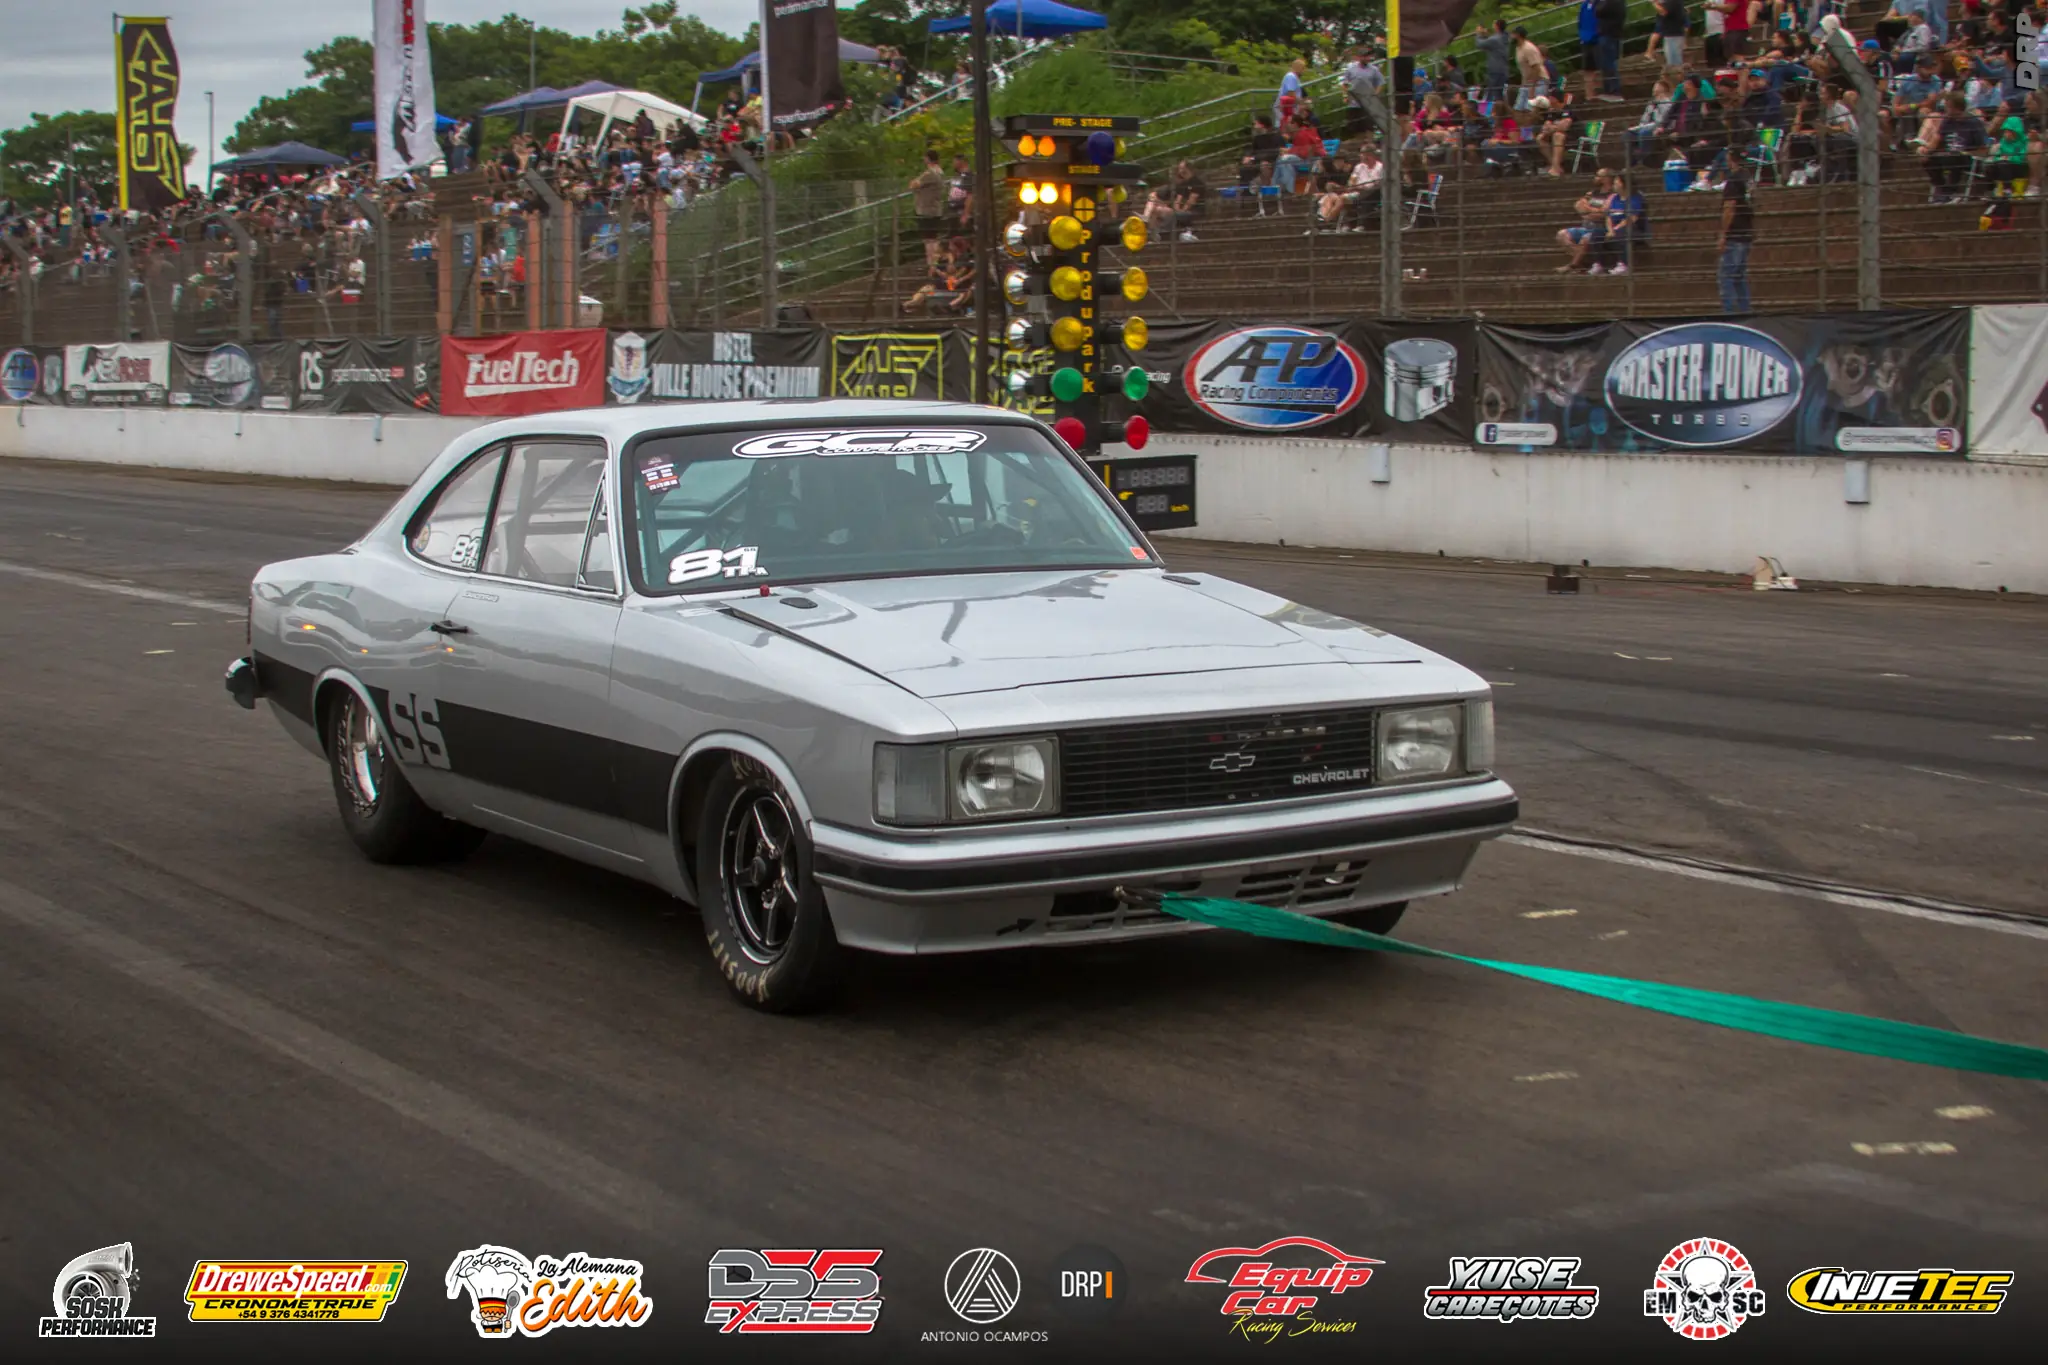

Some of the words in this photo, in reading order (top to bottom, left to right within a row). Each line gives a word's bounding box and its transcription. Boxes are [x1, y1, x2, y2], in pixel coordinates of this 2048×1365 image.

[1053, 117, 1077, 127] PRE-
[1080, 117, 1112, 127] STAGE
[1068, 164, 1100, 174] STAGE
[465, 350, 579, 385] FuelTech
[691, 363, 742, 398] HOUSE
[743, 366, 820, 398] PREMIUM
[1618, 343, 1703, 401] MASTER
[1710, 342, 1789, 401] POWER
[1201, 384, 1243, 401] Racing
[1250, 385, 1339, 401] Components
[1651, 413, 1750, 425] TURBO
[668, 546, 759, 584] 81
[388, 690, 452, 770] SS
[1293, 768, 1370, 784] CHEVROLET
